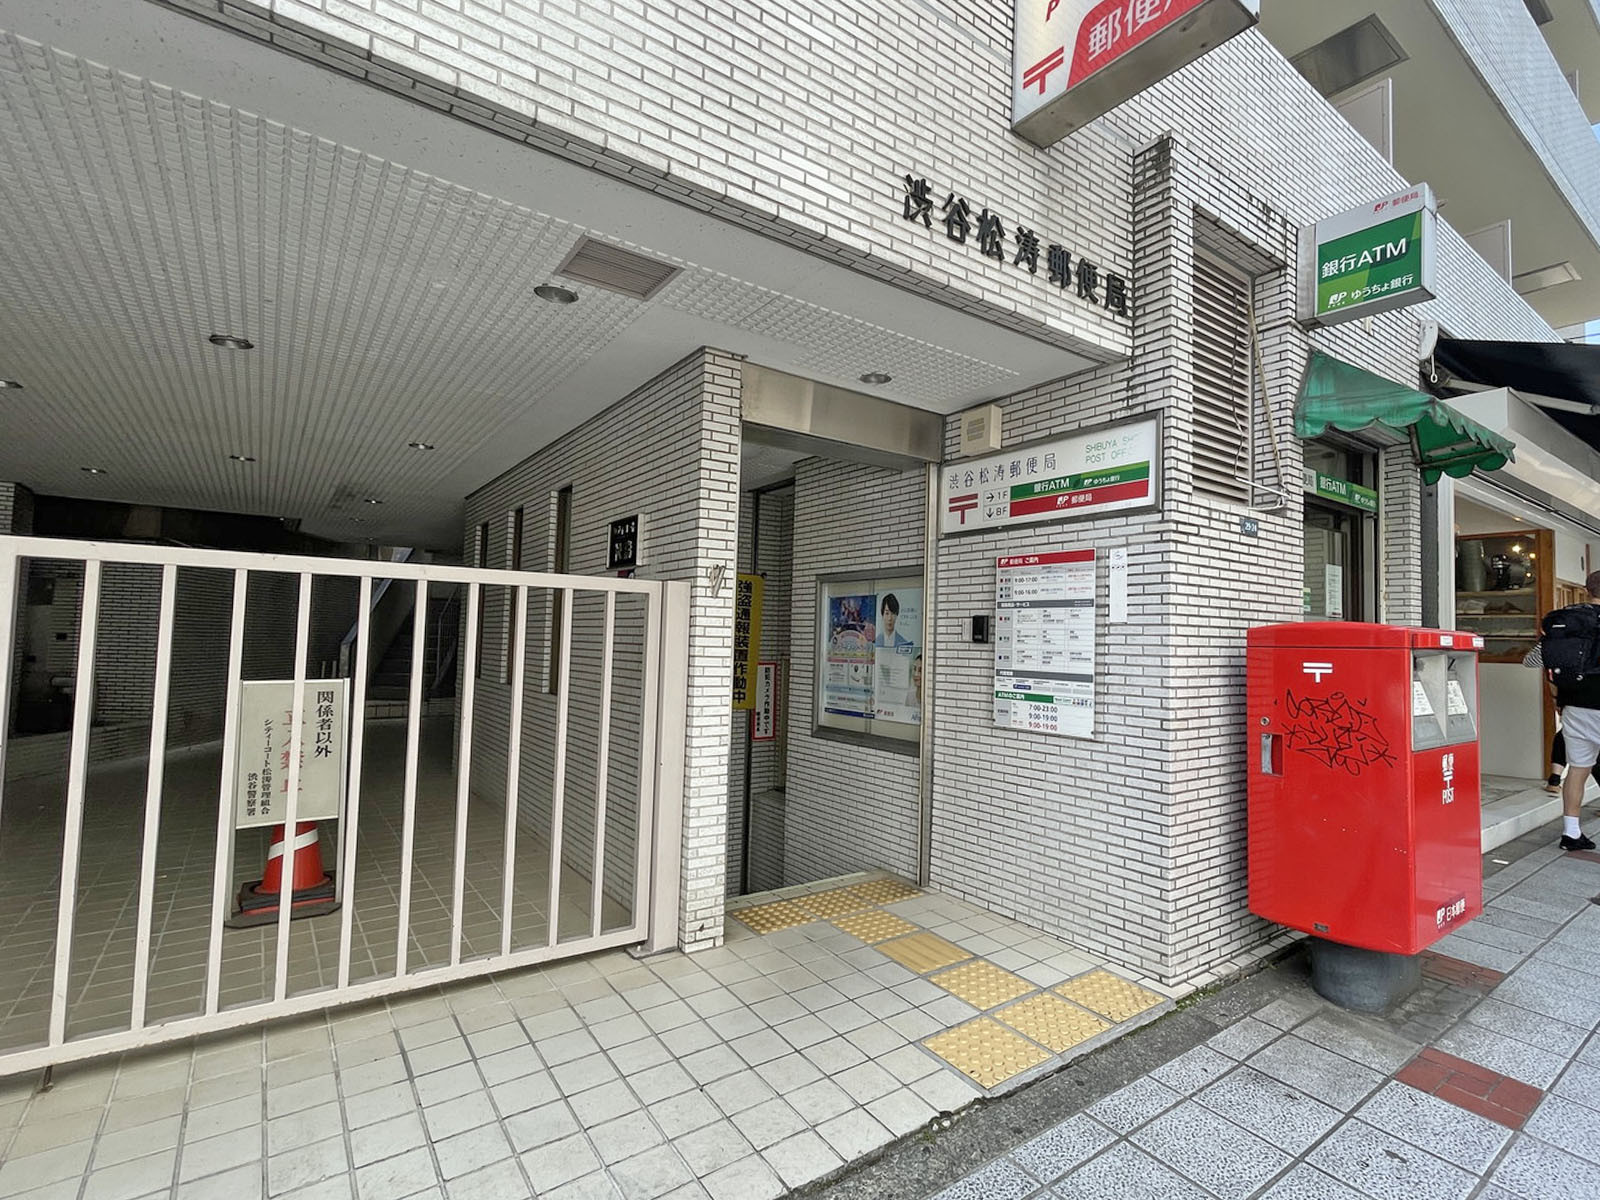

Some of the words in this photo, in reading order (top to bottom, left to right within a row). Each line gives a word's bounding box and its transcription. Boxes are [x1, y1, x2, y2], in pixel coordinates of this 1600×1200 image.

[1088, 0, 1170, 62] 郵便
[1321, 237, 1407, 279] 銀行ATM
[1351, 275, 1414, 300] ゆうちょ銀行
[1085, 452, 1105, 464] POST
[1033, 477, 1070, 493] 銀行ATM
[1071, 493, 1093, 504] 郵便局
[733, 580, 753, 704] 強盗通報装置作動中
[314, 690, 335, 759] 関係者以外
[1442, 787, 1454, 805] POST
